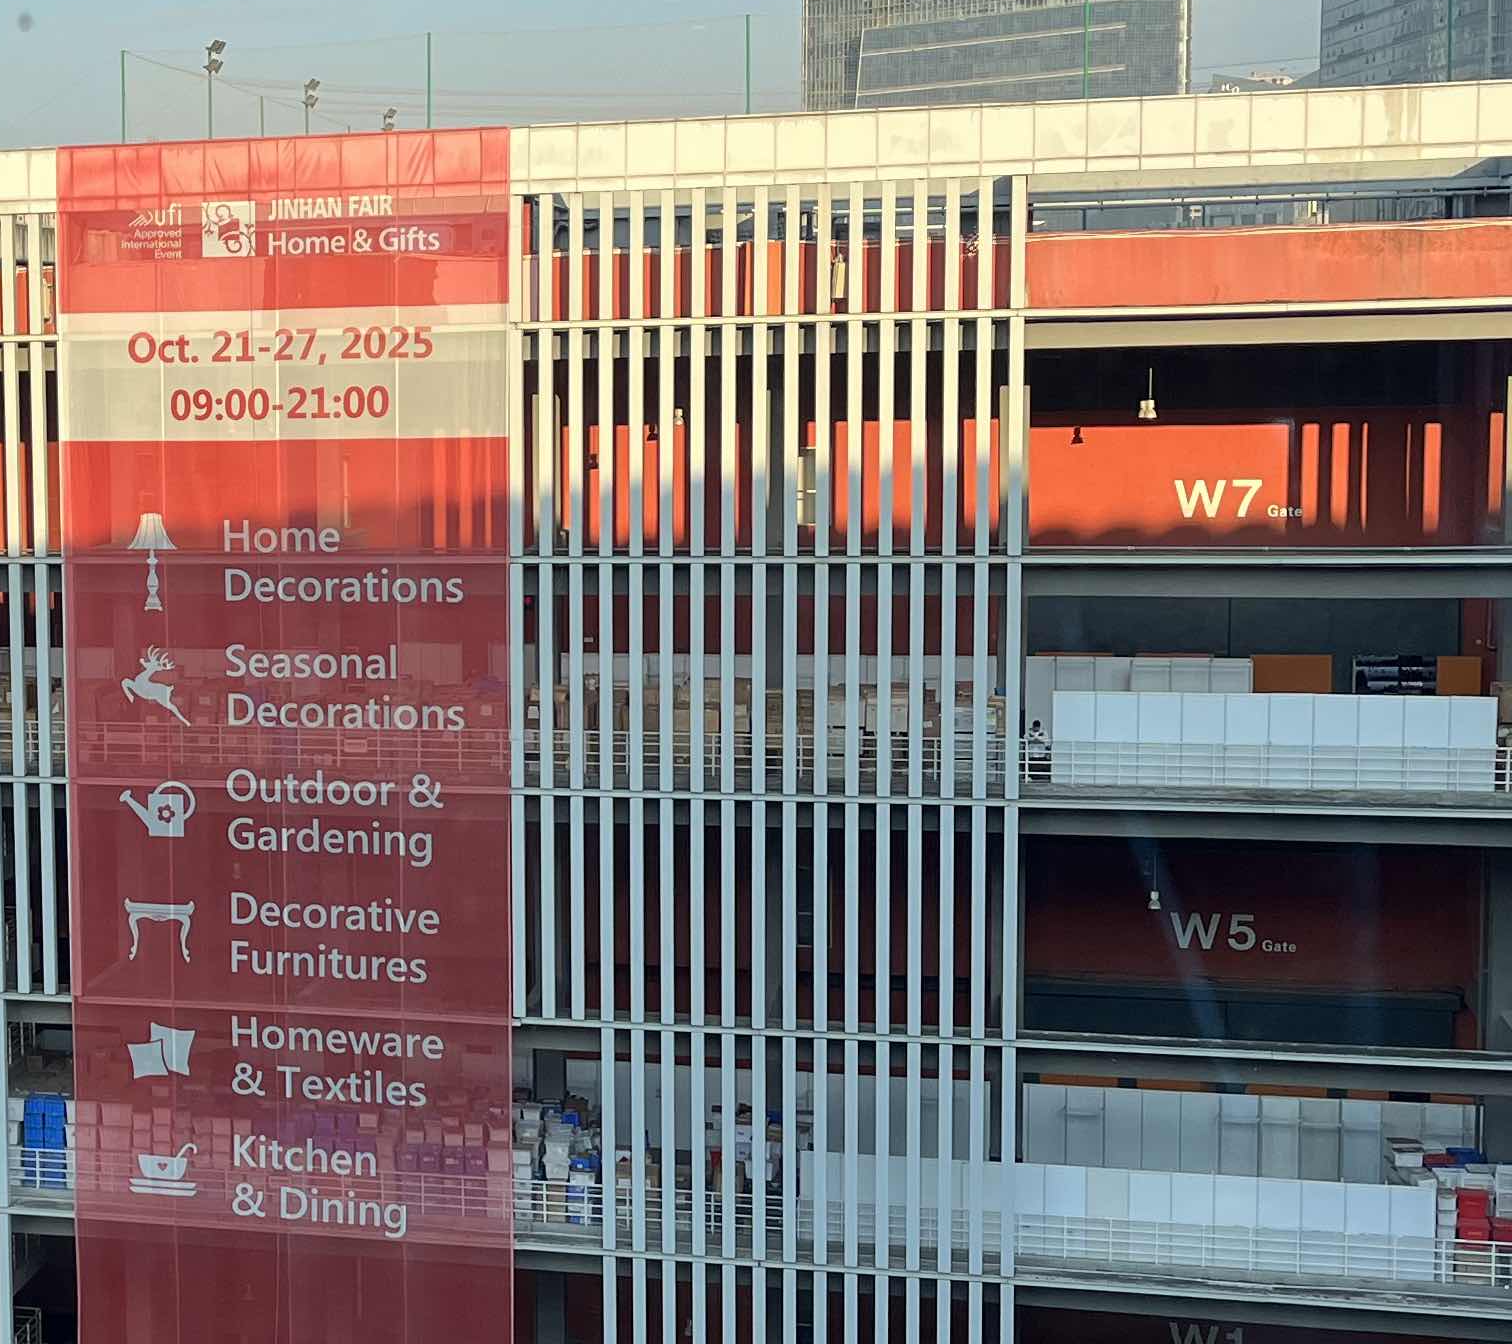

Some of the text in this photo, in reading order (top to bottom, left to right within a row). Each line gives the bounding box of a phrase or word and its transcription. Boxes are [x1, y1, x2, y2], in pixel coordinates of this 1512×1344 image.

[155, 203, 182, 226] ufi
[268, 195, 392, 221] JINHAN FAIR
[135, 229, 182, 239] Approved
[268, 225, 440, 256] Home & Gifts
[155, 250, 182, 259] Event
[128, 326, 433, 366] Oct. 21-27, 2025
[170, 385, 390, 422] 09:00-21:00
[1174, 479, 1303, 518] W7 Gate
[223, 520, 342, 553] Home
[223, 568, 465, 604] Decorations
[226, 644, 398, 681] Seasonal
[227, 693, 466, 731] Decorations
[226, 769, 444, 809] Outdoor &
[227, 818, 433, 868] Gardening
[230, 892, 441, 935] Decorative
[1170, 913, 1297, 954] W5 Gate
[230, 940, 429, 984] Furnitures
[231, 1016, 445, 1060] Homeware
[231, 1063, 427, 1108] & Textiles
[232, 1134, 378, 1178] Kitchen
[231, 1183, 408, 1238] & Dining
